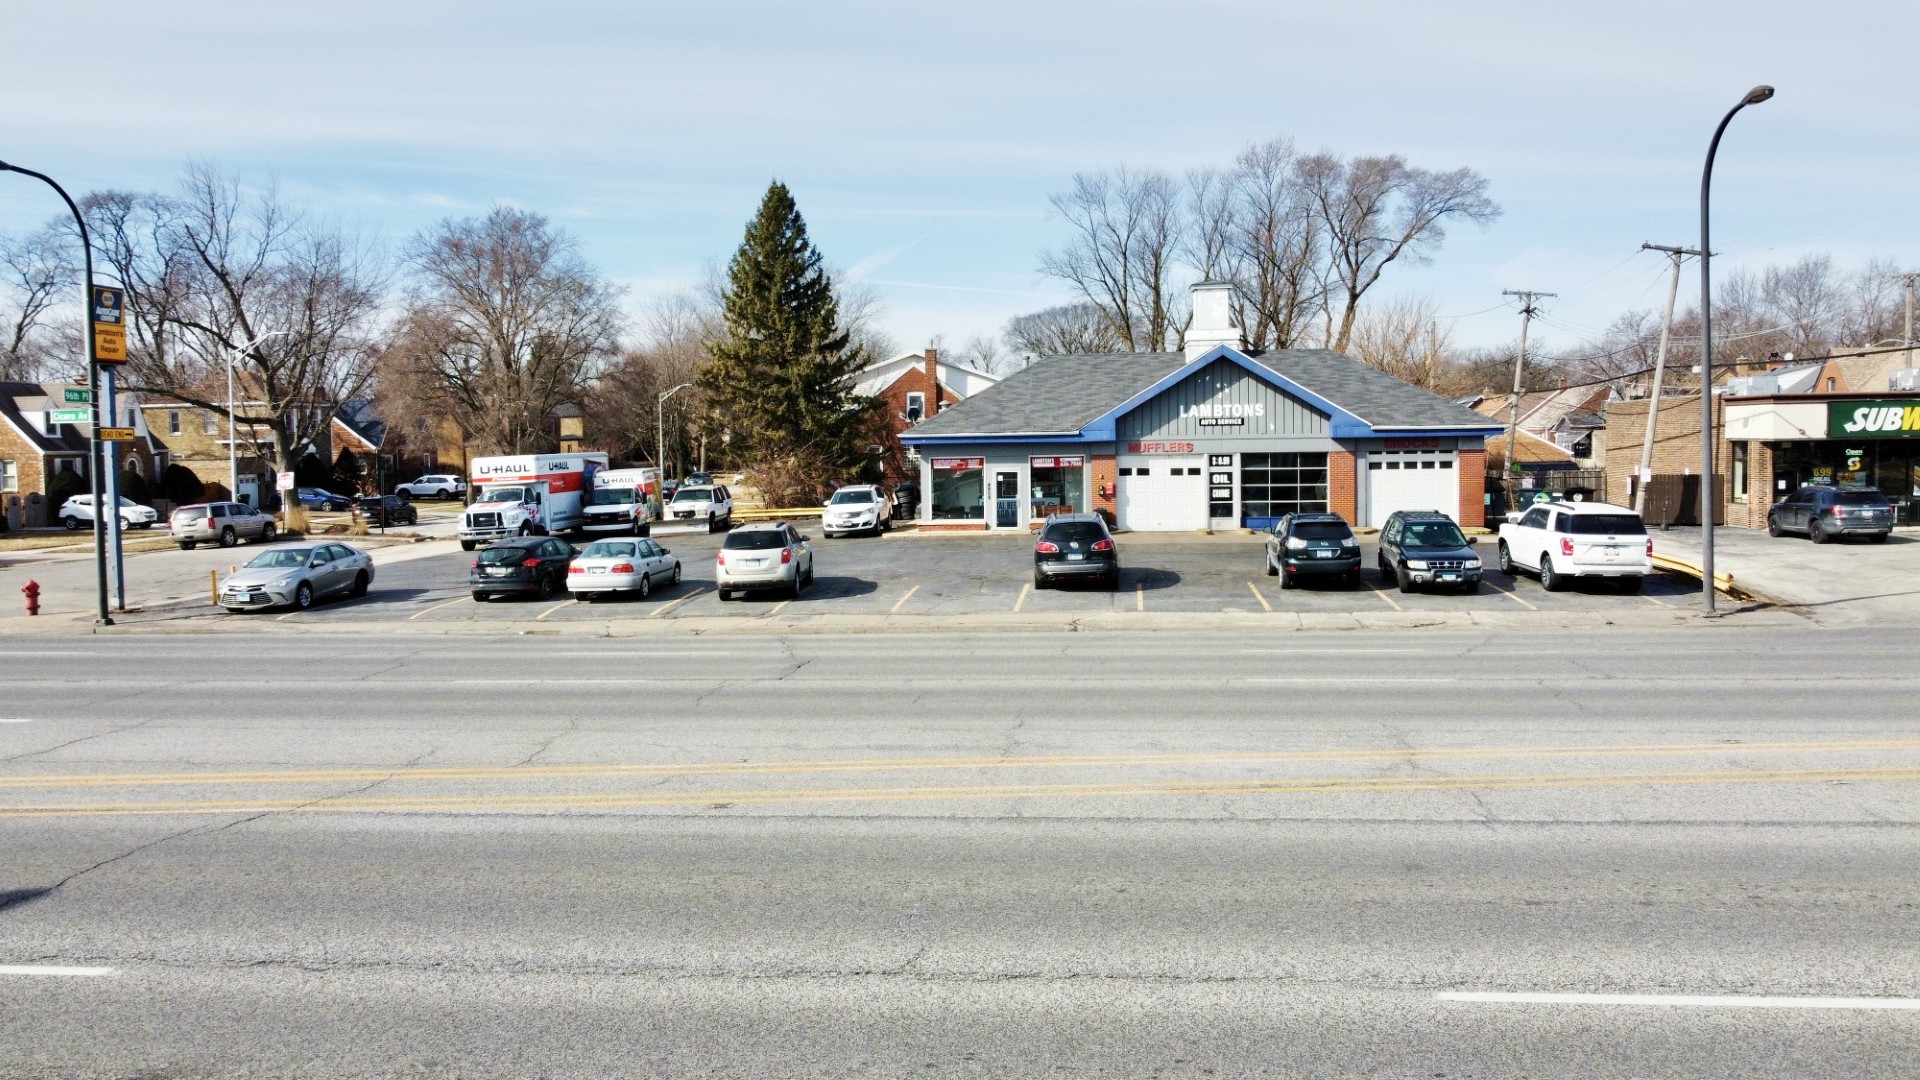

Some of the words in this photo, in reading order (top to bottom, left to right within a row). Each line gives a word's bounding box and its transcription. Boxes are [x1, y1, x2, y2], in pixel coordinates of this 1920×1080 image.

[103, 337, 117, 345] Auto
[101, 345, 119, 354] Repair
[65, 391, 80, 400] 96th
[53, 411, 76, 420] Cicero
[78, 411, 88, 420] Av
[1180, 404, 1264, 418] LAMBTONS
[1200, 418, 1216, 426] AUTO
[100, 430, 114, 438] DEAD
[115, 430, 125, 438] END
[1128, 442, 1194, 453] MUFFLERS
[480, 464, 530, 474] U-HAUL
[548, 461, 570, 471] U-HAUL
[1212, 474, 1231, 484] OIL
